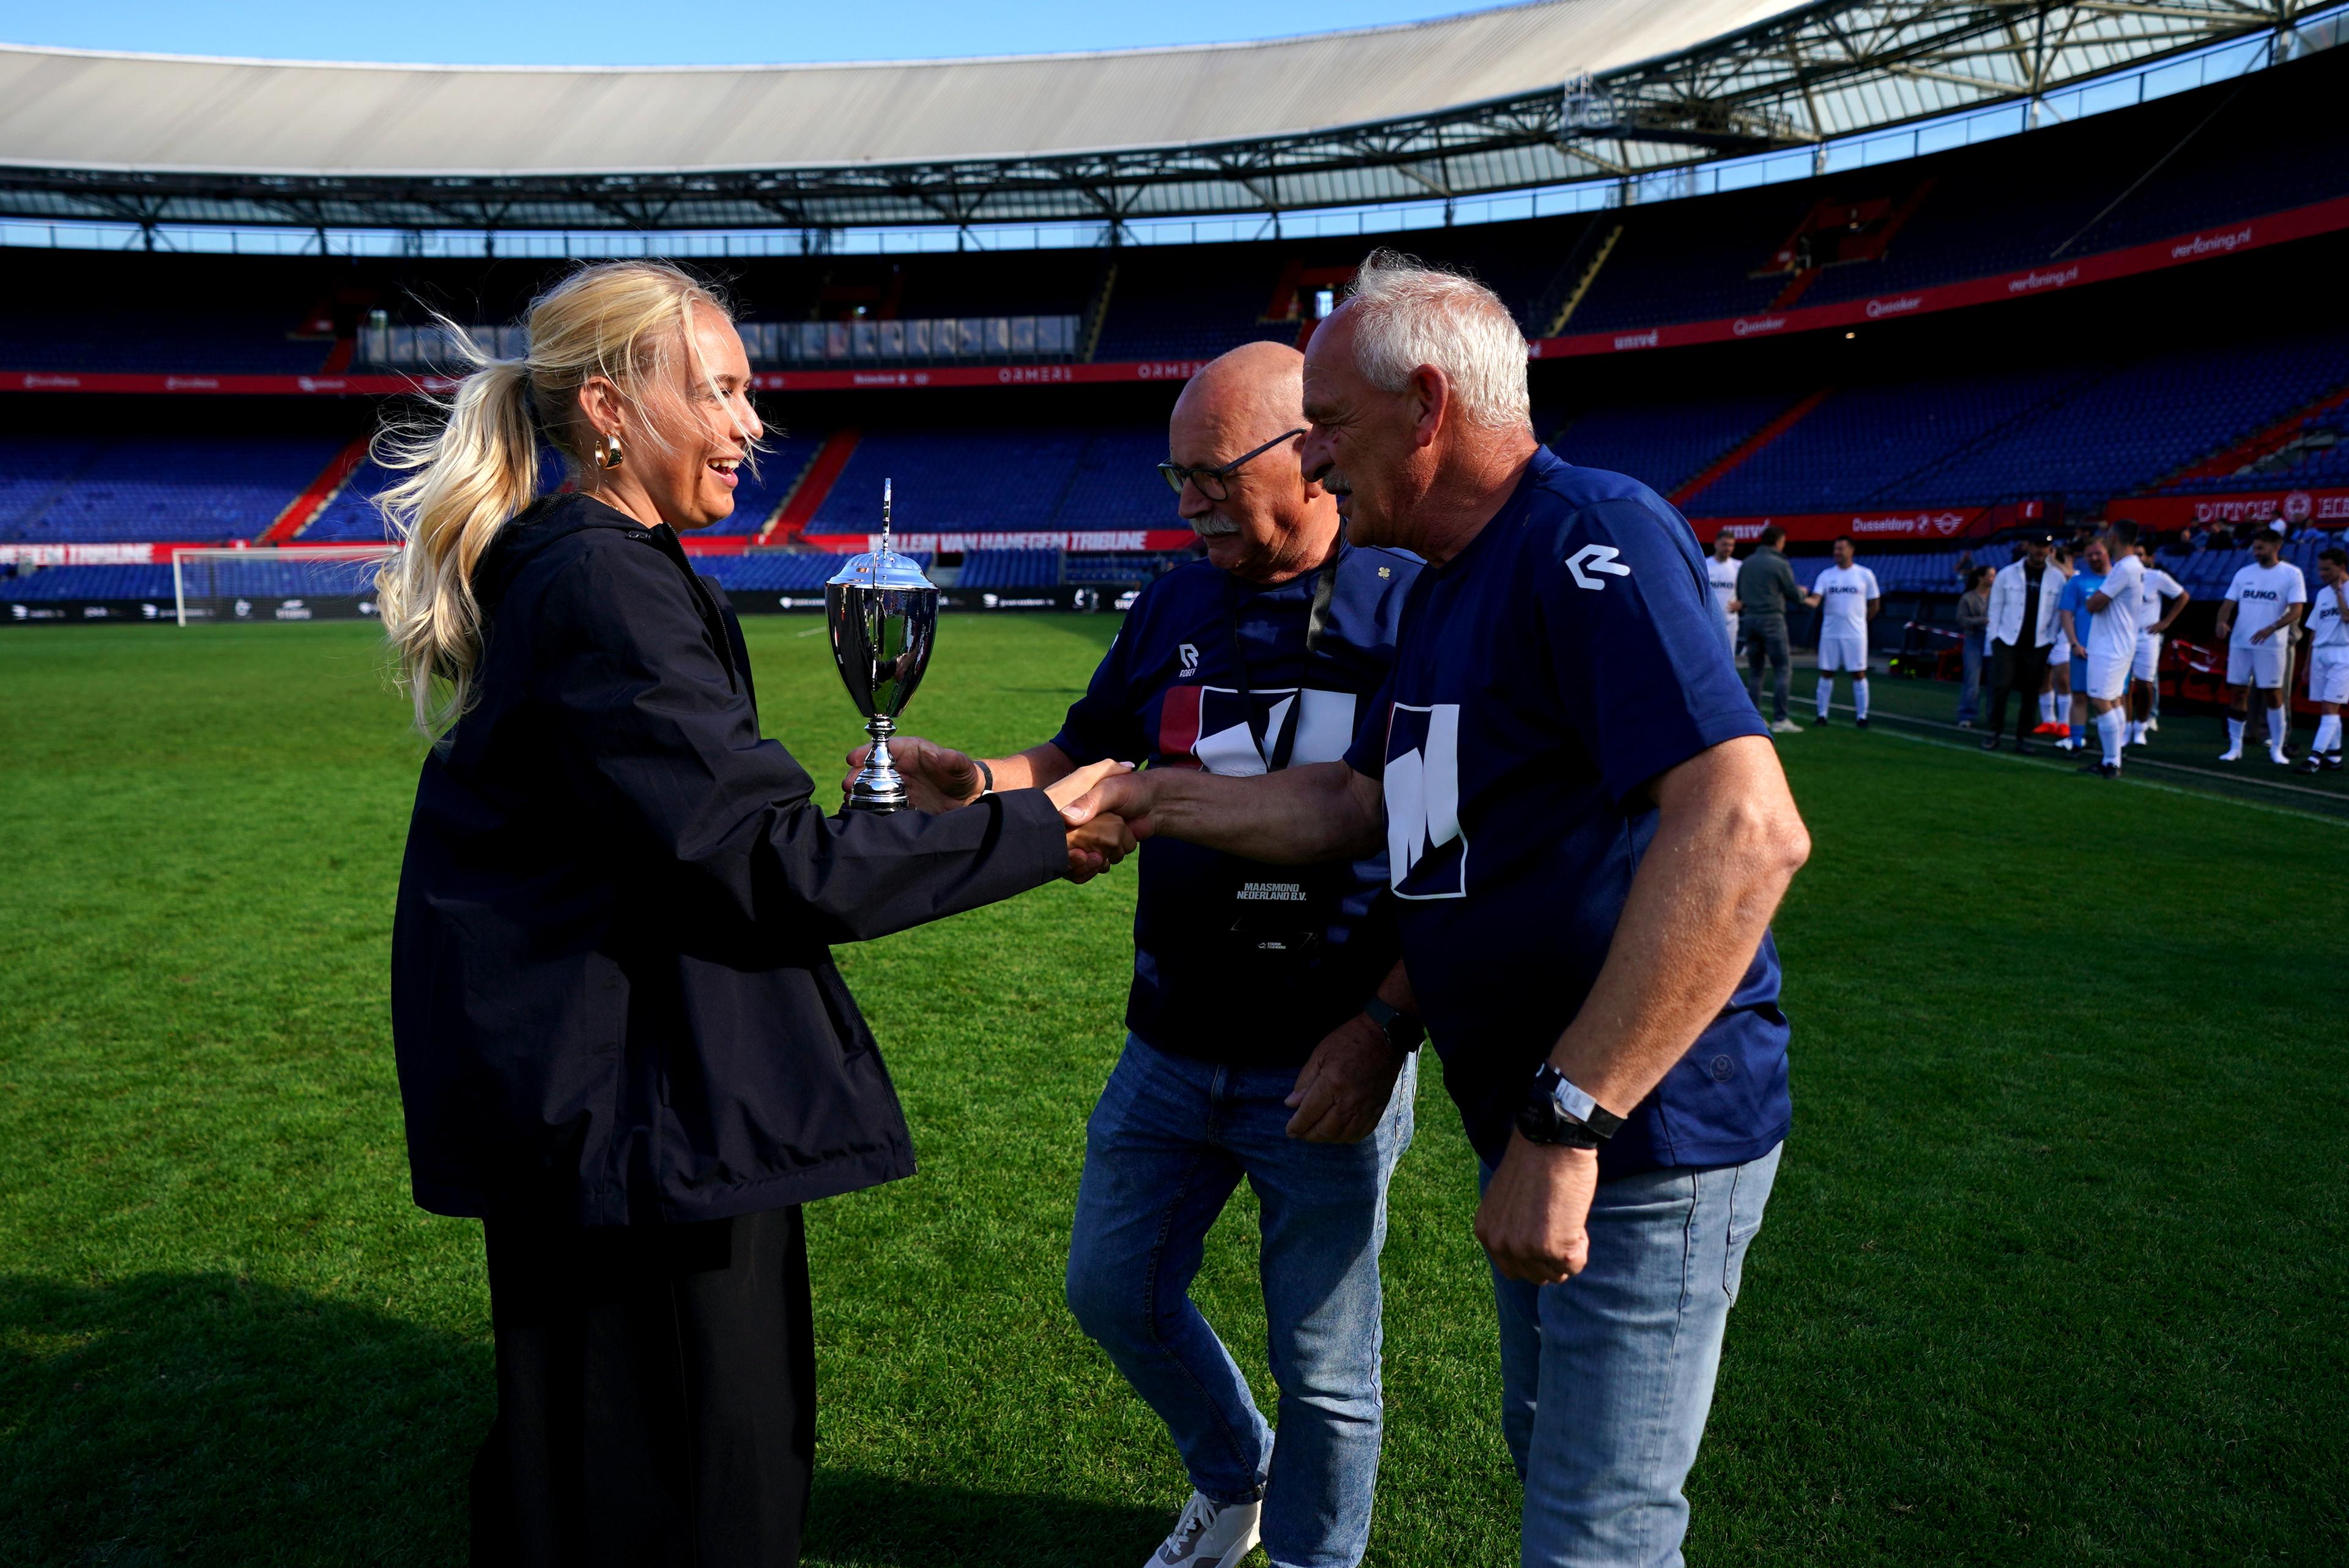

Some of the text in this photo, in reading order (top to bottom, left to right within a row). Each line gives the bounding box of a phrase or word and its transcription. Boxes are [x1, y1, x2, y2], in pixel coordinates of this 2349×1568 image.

[1137, 363, 1203, 379] ORMER
[1852, 517, 1914, 533] Dusseldorp
[1244, 883, 1299, 892] MAASMOND
[1237, 891, 1307, 901] NEDERLAND B.V.
